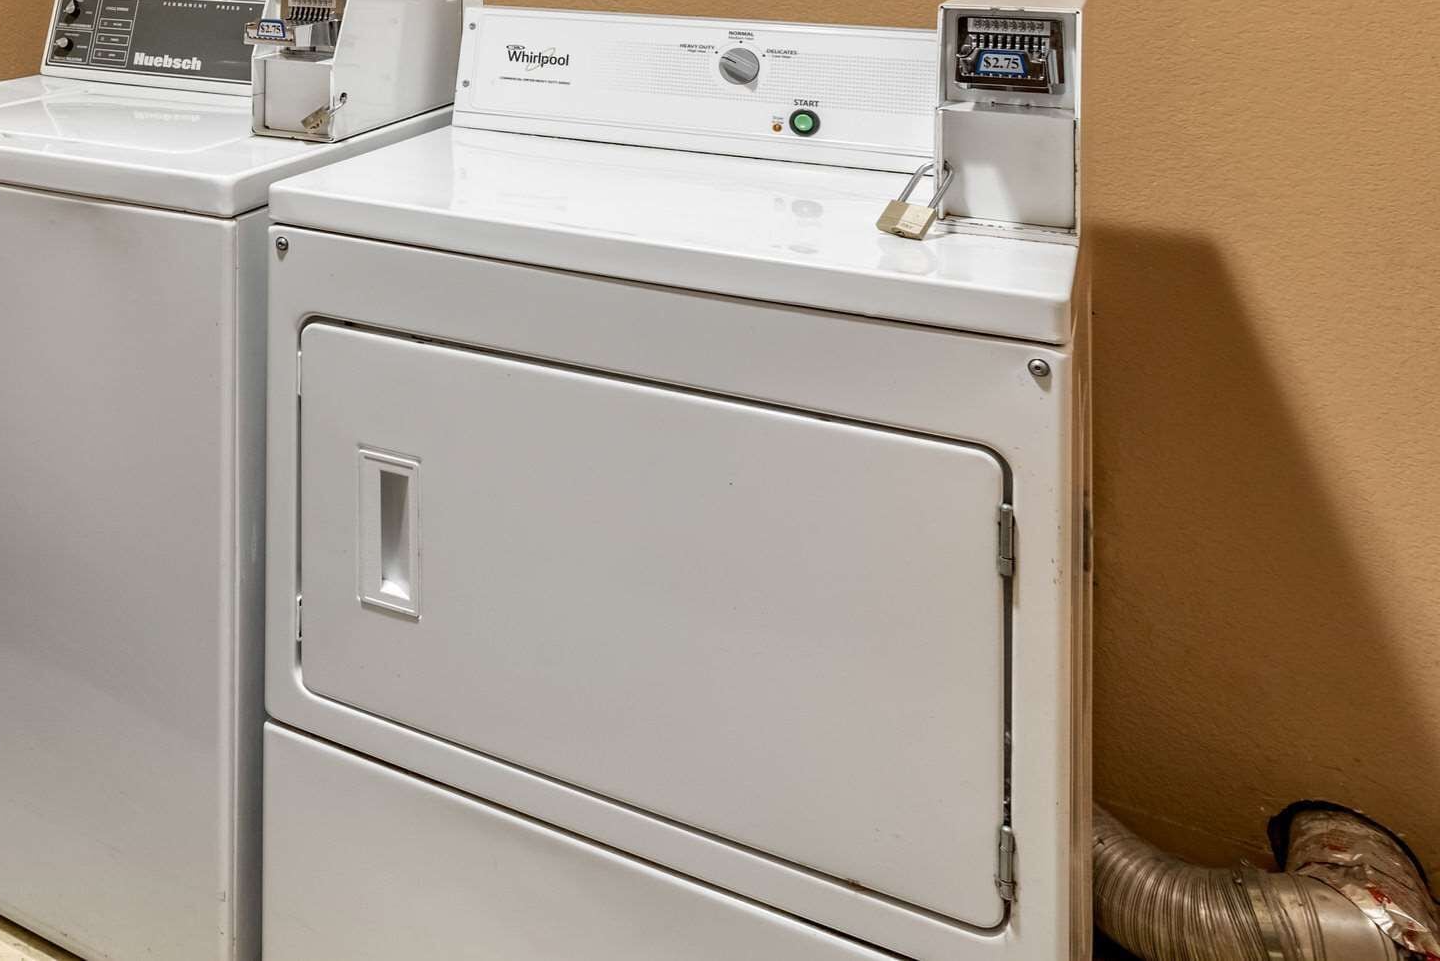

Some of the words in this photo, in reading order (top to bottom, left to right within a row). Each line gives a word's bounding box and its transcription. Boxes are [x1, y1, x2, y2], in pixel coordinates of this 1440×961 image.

[260, 22, 281, 34] $2.75
[133, 52, 202, 70] Huebsch
[507, 50, 570, 68] Whirlpool
[983, 56, 1019, 69] $2.75
[793, 99, 820, 107] START
